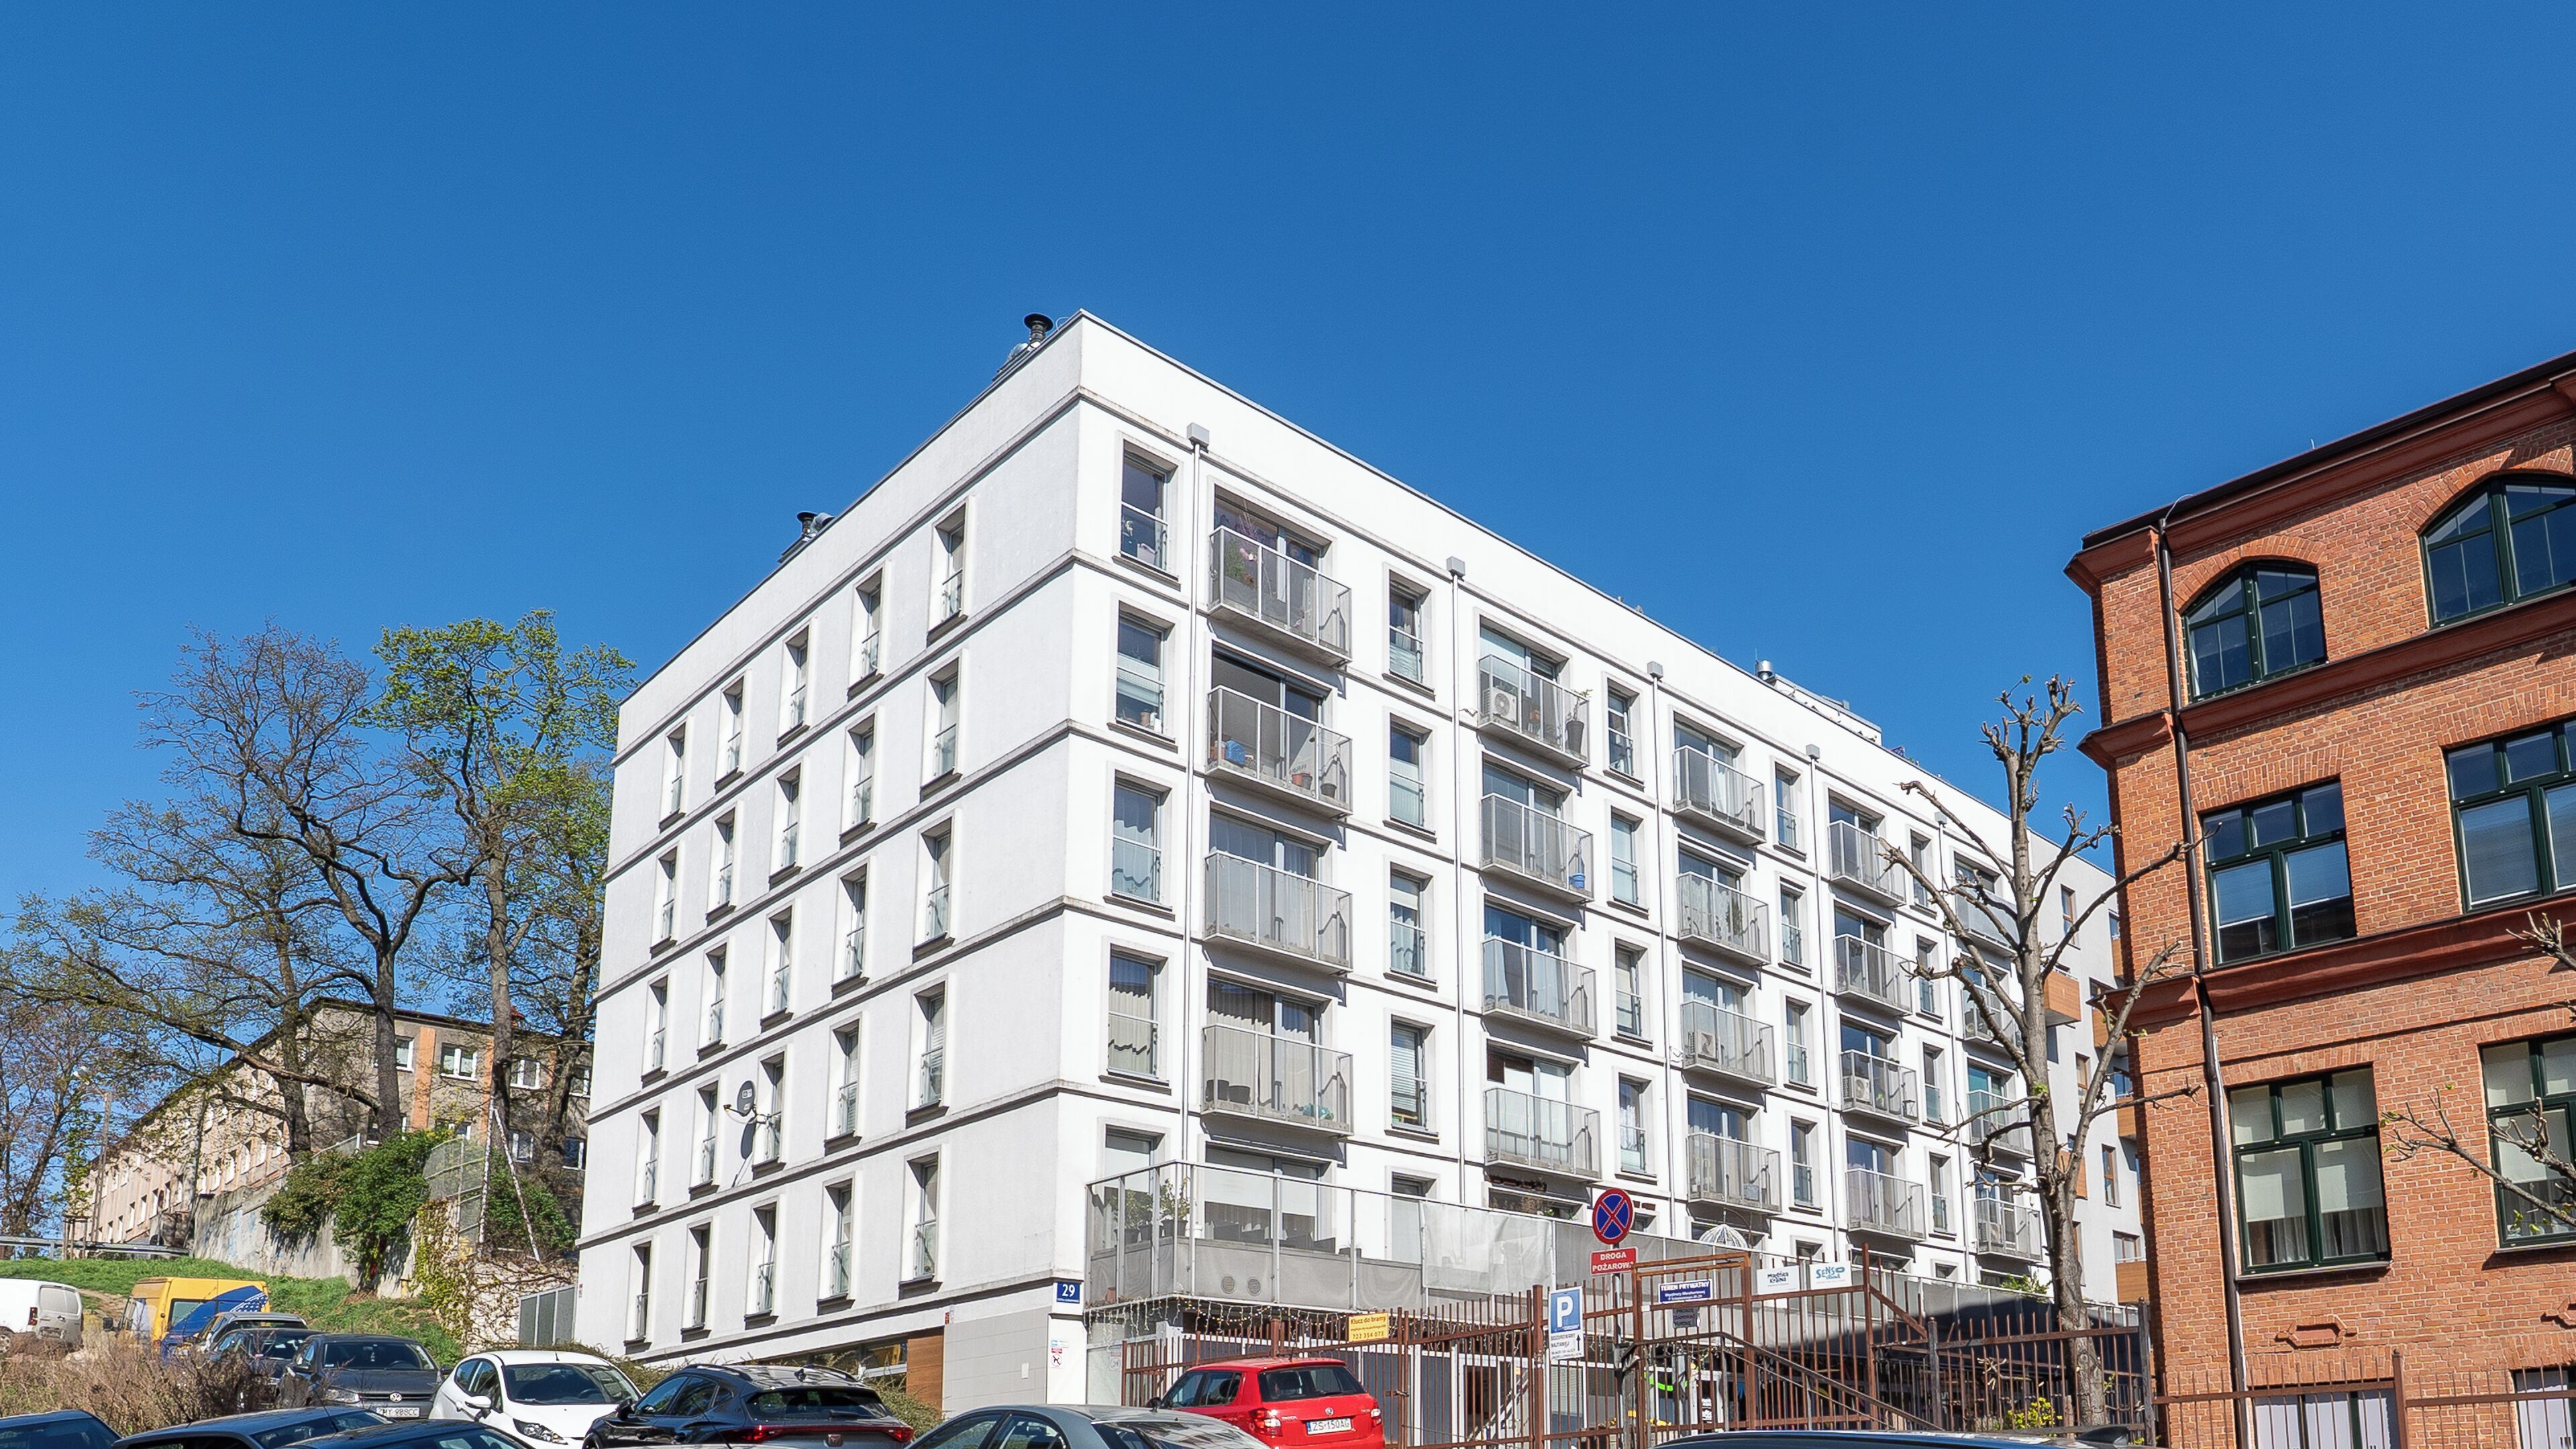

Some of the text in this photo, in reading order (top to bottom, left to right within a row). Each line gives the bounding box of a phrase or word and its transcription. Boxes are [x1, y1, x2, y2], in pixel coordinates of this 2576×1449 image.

[1600, 1251, 1627, 1260] DROGA
[1592, 1261, 1633, 1272] POŻAROW
[1816, 1267, 1845, 1279] SENSO
[1062, 1283, 1076, 1297] 29
[1557, 1295, 1574, 1328] P
[1312, 1421, 1325, 1432] ZS
